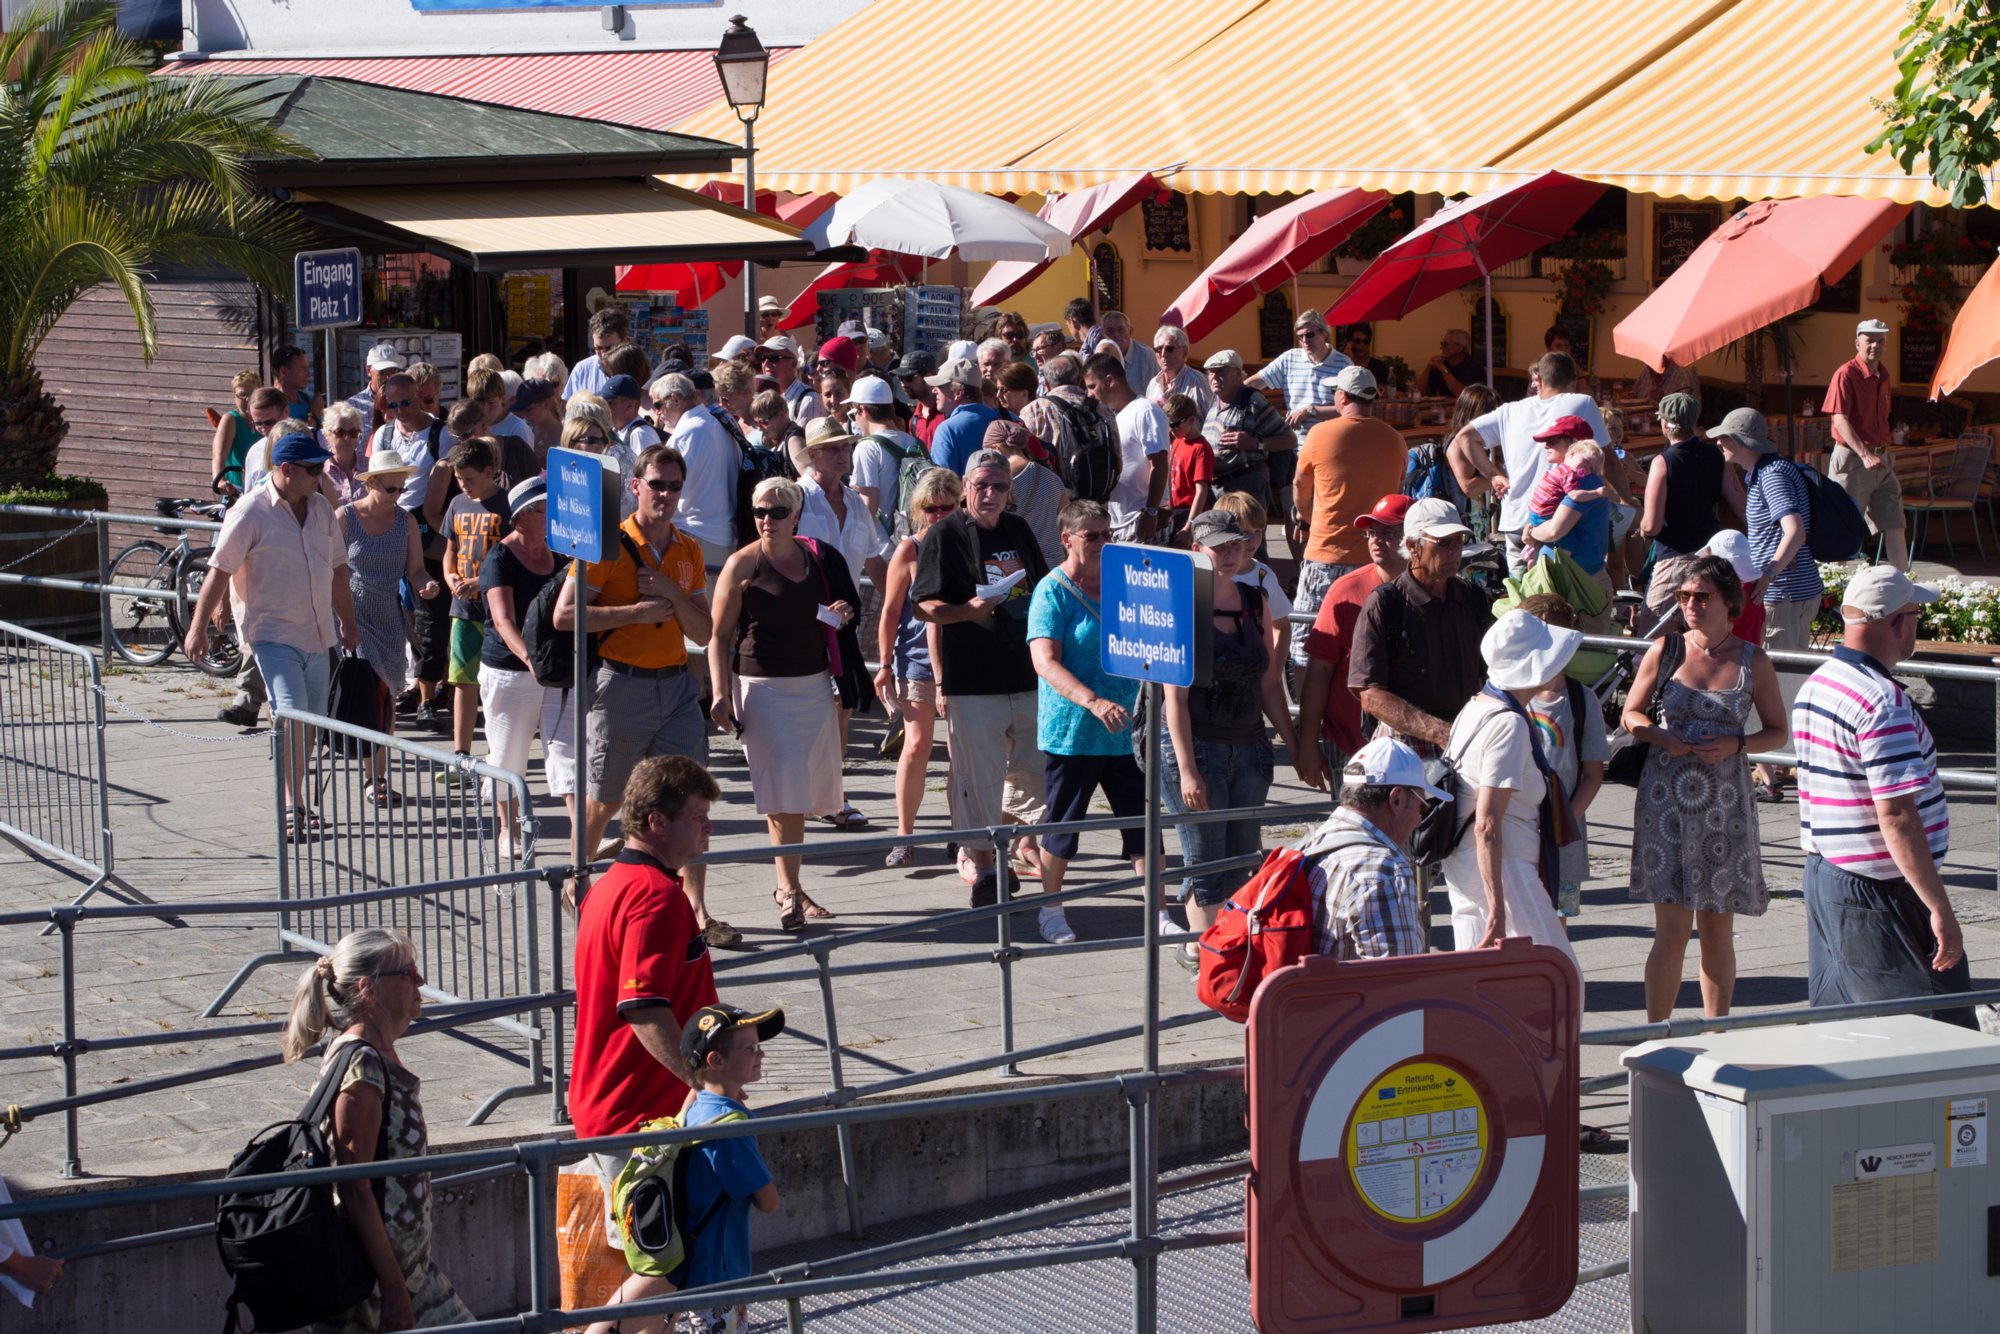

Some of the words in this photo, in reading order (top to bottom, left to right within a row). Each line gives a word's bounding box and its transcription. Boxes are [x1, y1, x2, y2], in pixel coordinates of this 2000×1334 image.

[1661, 231, 1696, 248] Cordon
[303, 261, 353, 288] Eingang
[310, 296, 339, 319] Platz
[343, 293, 349, 316] 1
[561, 464, 587, 487] Vorsicht
[557, 493, 568, 512] bei
[570, 497, 591, 517] Nässe
[454, 512, 502, 535] NEVER
[1124, 564, 1168, 589] Vorsicht
[1119, 600, 1136, 623] bei
[1139, 604, 1174, 628] Nässe
[1108, 633, 1186, 665] Rutschgefahr!
[1397, 1081, 1443, 1095] Ertrinkender
[1405, 1074, 1434, 1084] Rettung
[1408, 1147, 1419, 1155] 112
